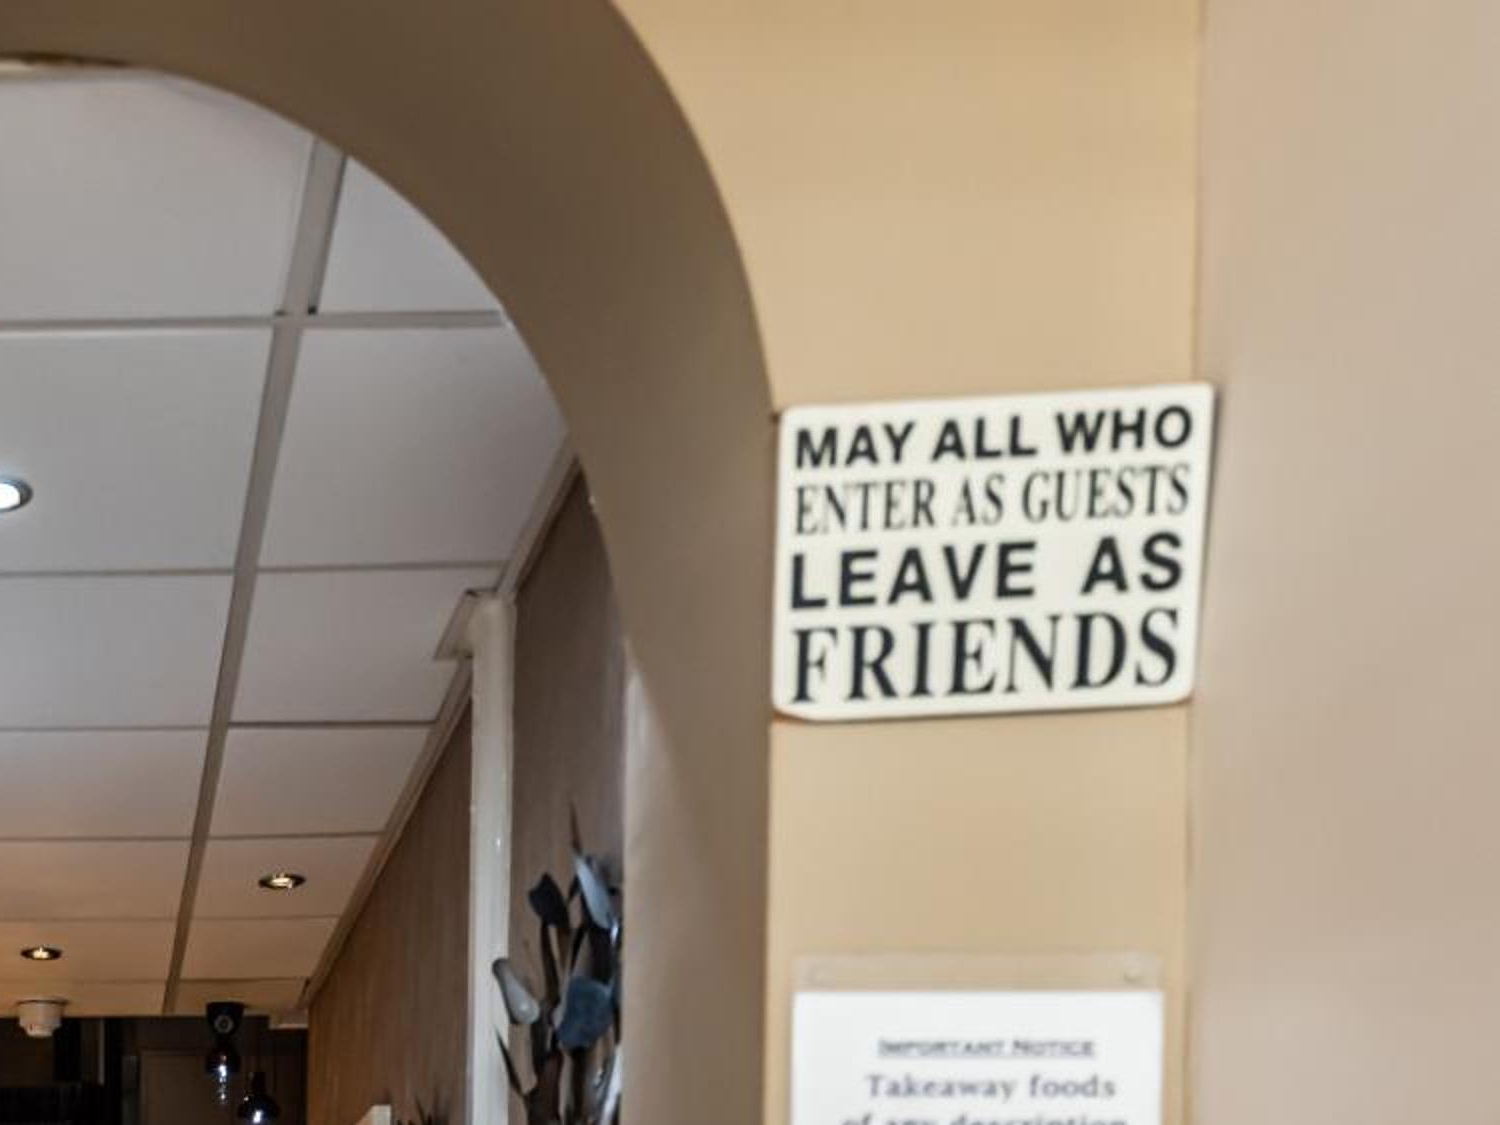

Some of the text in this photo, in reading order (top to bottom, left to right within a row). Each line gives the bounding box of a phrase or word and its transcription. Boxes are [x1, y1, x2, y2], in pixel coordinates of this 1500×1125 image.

[795, 405, 1192, 470] MAY ALL WHO
[795, 463, 1192, 536] ENTER AS GUESTS
[791, 531, 1183, 610] LEAVE AS
[790, 607, 1180, 705] FRIENDS
[866, 1074, 1116, 1101] Takeaway foods
